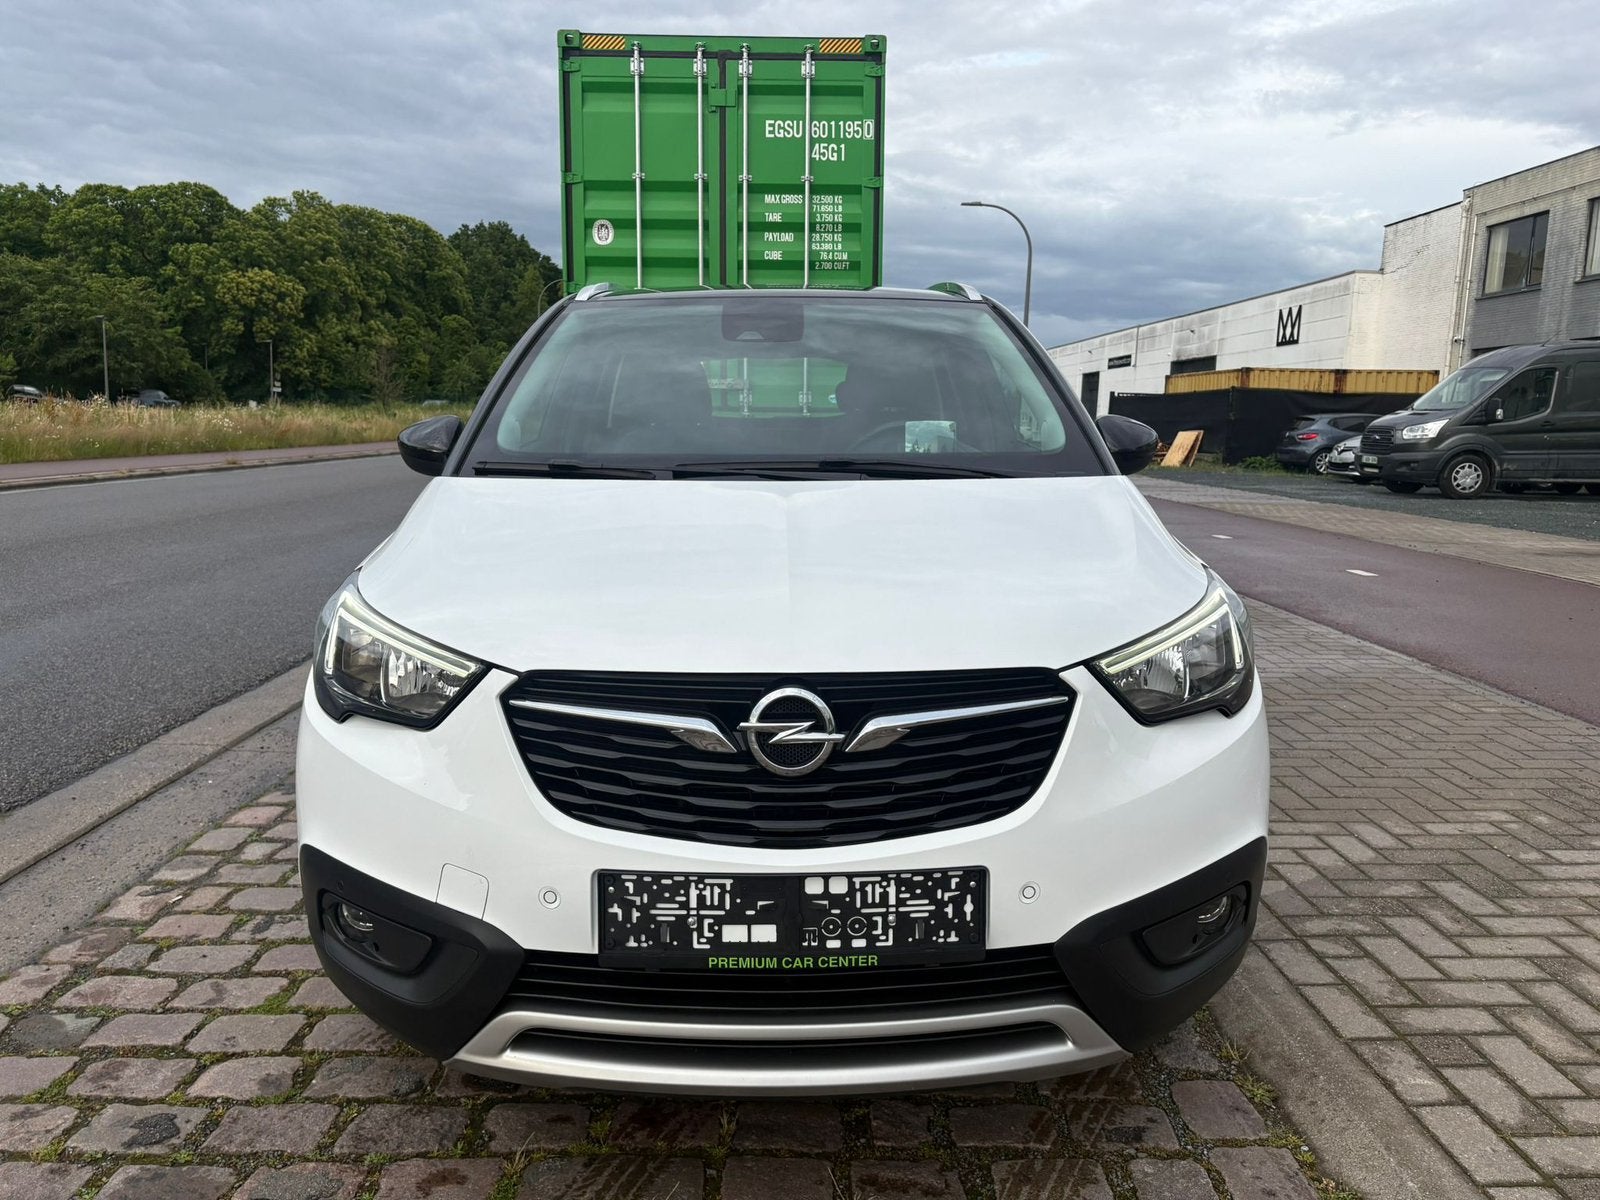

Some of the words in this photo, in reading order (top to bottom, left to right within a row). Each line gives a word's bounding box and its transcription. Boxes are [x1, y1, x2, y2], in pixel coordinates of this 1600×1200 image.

[765, 119, 803, 138] EGSU
[811, 119, 875, 140] 6011950
[811, 143, 846, 161] 45G1
[764, 194, 780, 204] MAX
[781, 194, 803, 204] GROSS
[812, 195, 833, 204] 32.500
[834, 195, 843, 204] KG
[813, 204, 833, 212] 71.650
[834, 204, 843, 212] LB
[764, 212, 783, 222] TARE
[815, 213, 833, 222] 3.750
[834, 213, 843, 222] KG
[815, 223, 833, 232] 8.270
[834, 224, 843, 232] LB
[764, 232, 794, 242] PAYLOAD
[811, 233, 833, 242] 28.750
[834, 233, 842, 242] KG
[833, 242, 842, 250] LB
[764, 250, 783, 260] CUBE
[819, 251, 833, 260] 76.4
[815, 261, 833, 270] 2.700
[708, 956, 778, 969] PREMIUM
[782, 957, 814, 969] CAR
[818, 954, 879, 968] CENTER
